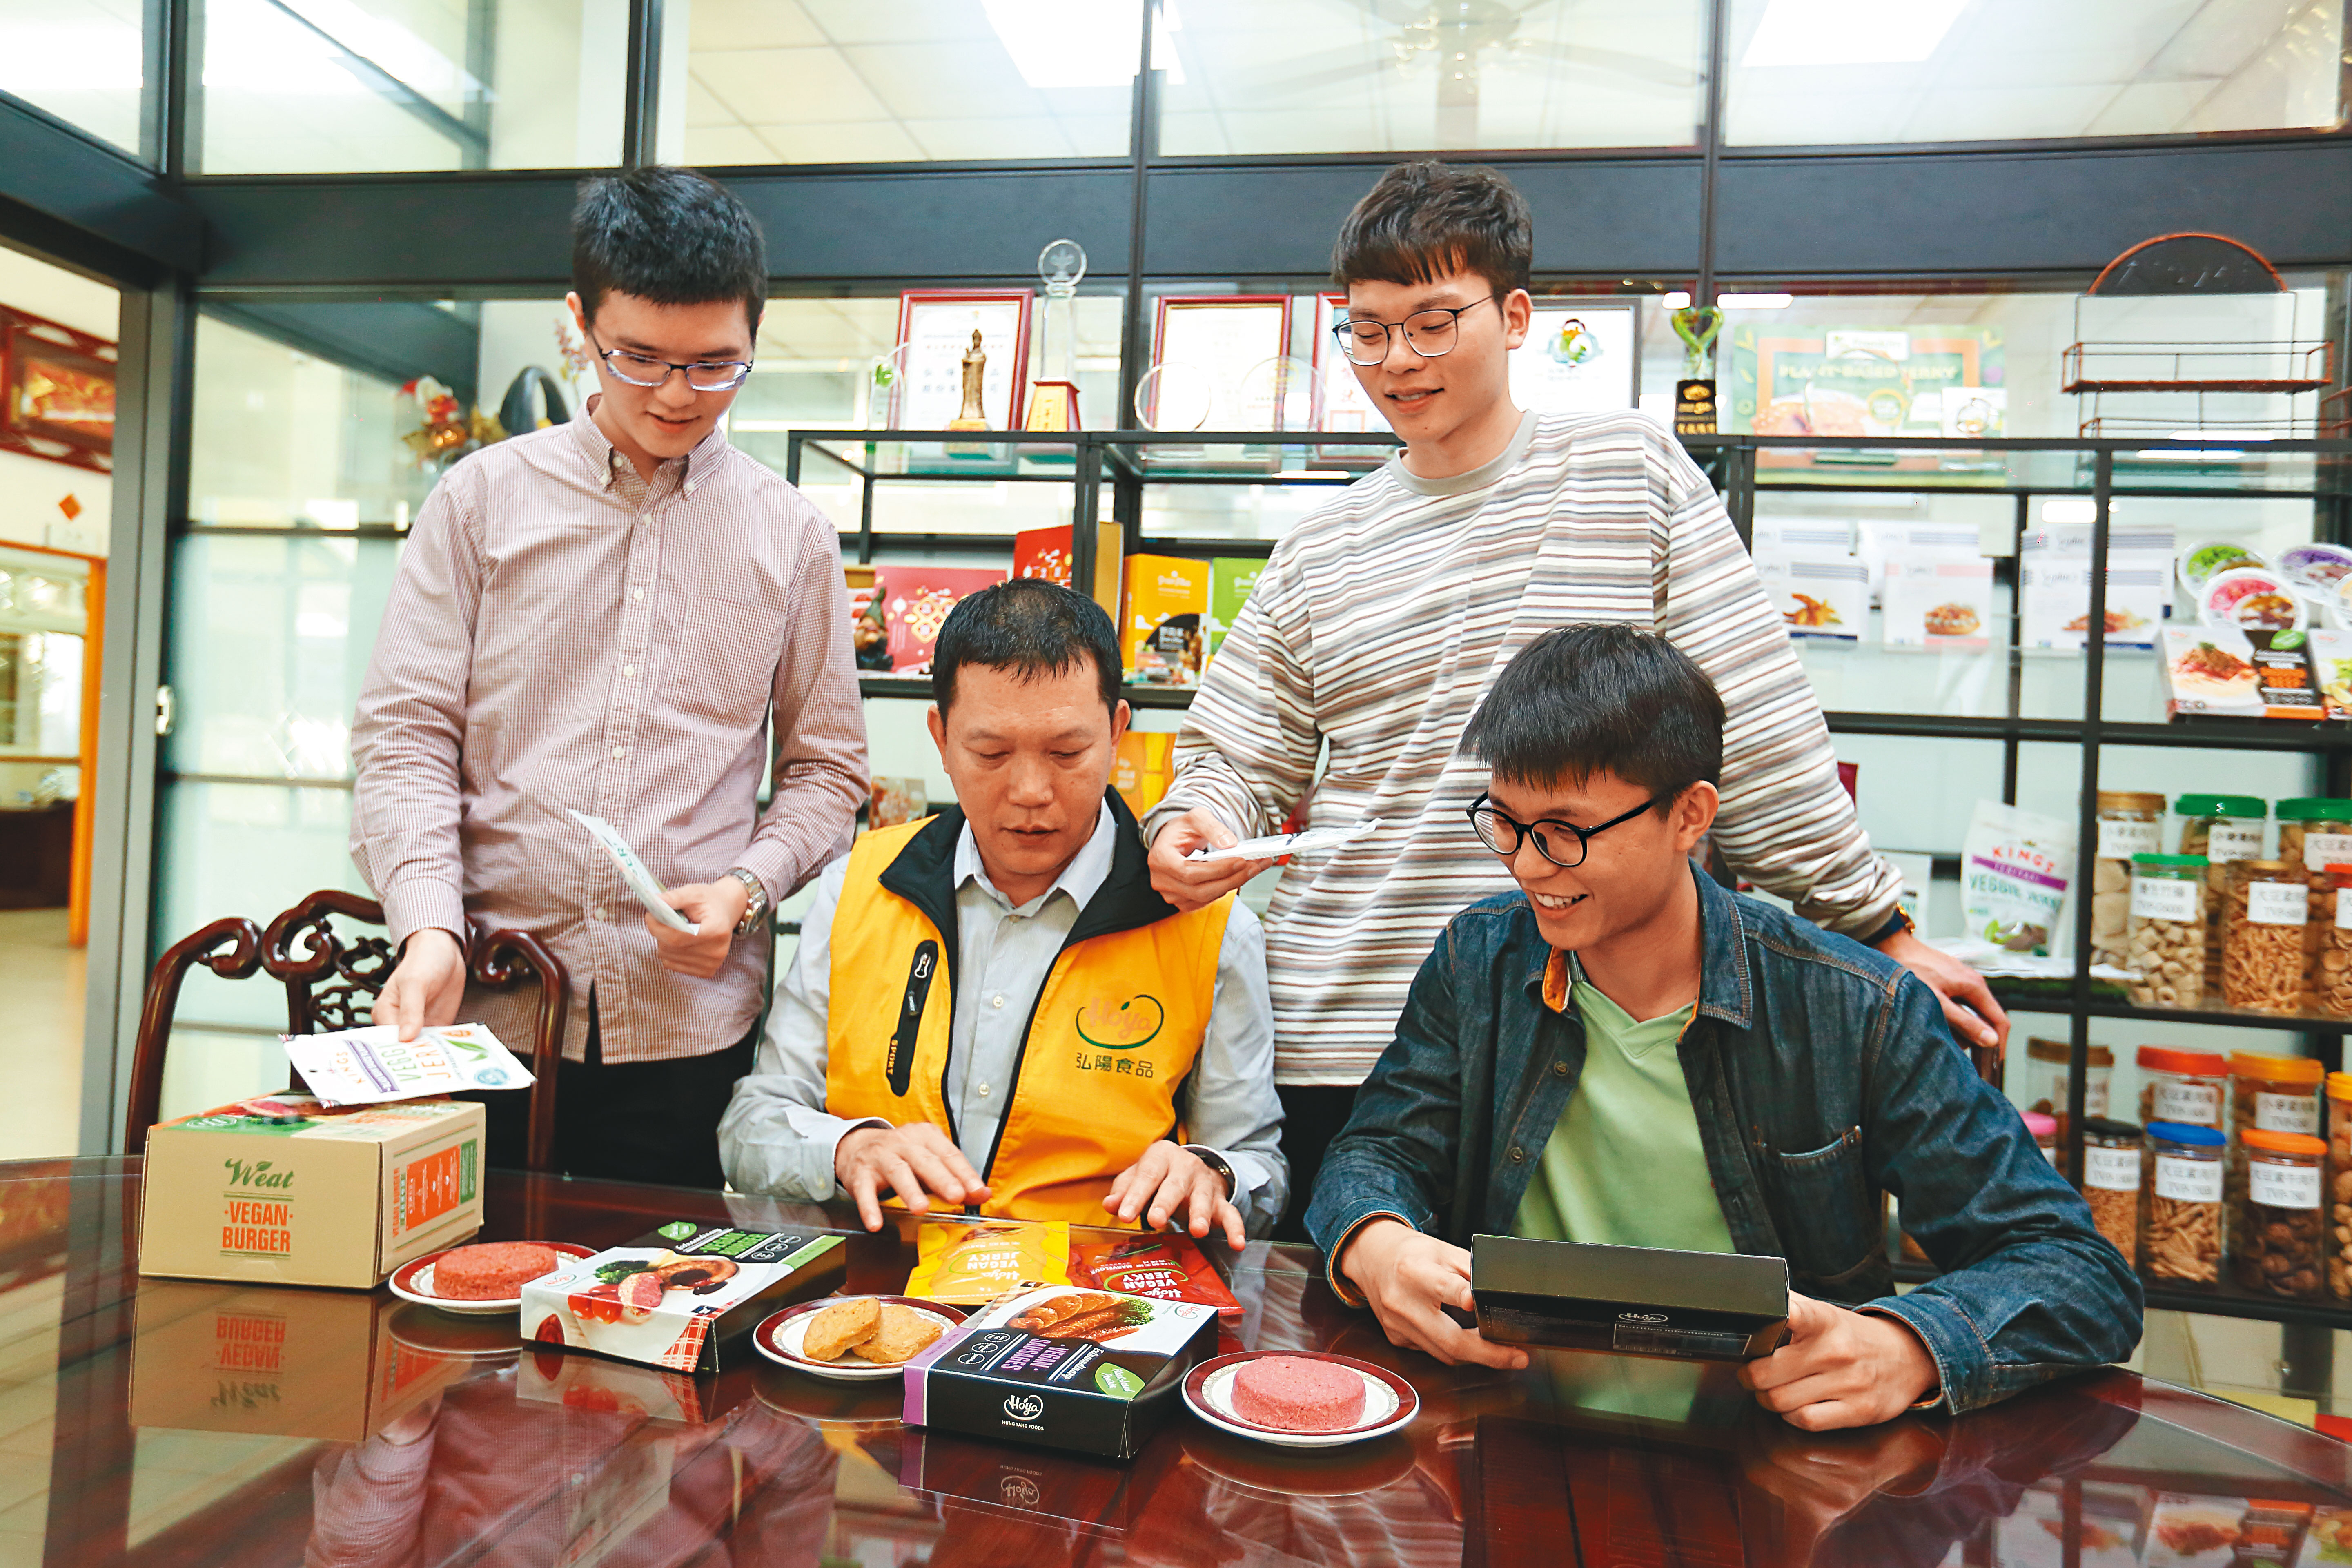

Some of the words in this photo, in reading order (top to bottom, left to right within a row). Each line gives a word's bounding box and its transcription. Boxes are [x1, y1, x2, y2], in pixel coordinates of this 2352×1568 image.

[1992, 846, 2055, 873] KINGS
[1085, 997, 1154, 1040] Hoya
[336, 1051, 365, 1084] KINGS
[374, 1042, 422, 1082] VEGGI
[411, 1040, 451, 1078] JERK
[887, 1039, 898, 1075] SPORT
[1076, 1052, 1154, 1078] 弘陽食品
[225, 1157, 295, 1189] Weat
[229, 1201, 288, 1227] VEGAN
[222, 1226, 291, 1252] BURGER
[967, 1260, 1019, 1270] VEGAN
[968, 1251, 1020, 1262] JERKY
[982, 1270, 1020, 1281] Hoya
[1122, 1271, 1172, 1282] JERKY
[1123, 1278, 1178, 1290] VEGAN
[1142, 1287, 1183, 1298] Hoya
[1181, 1305, 1201, 1316] Hoya
[1626, 1313, 1662, 1321] Hoya
[1000, 1337, 1052, 1371] SAUSAGES
[1029, 1346, 1069, 1369] VEGAN
[1061, 1348, 1105, 1381] Extraordinary
[1008, 1394, 1039, 1416] Hoya
